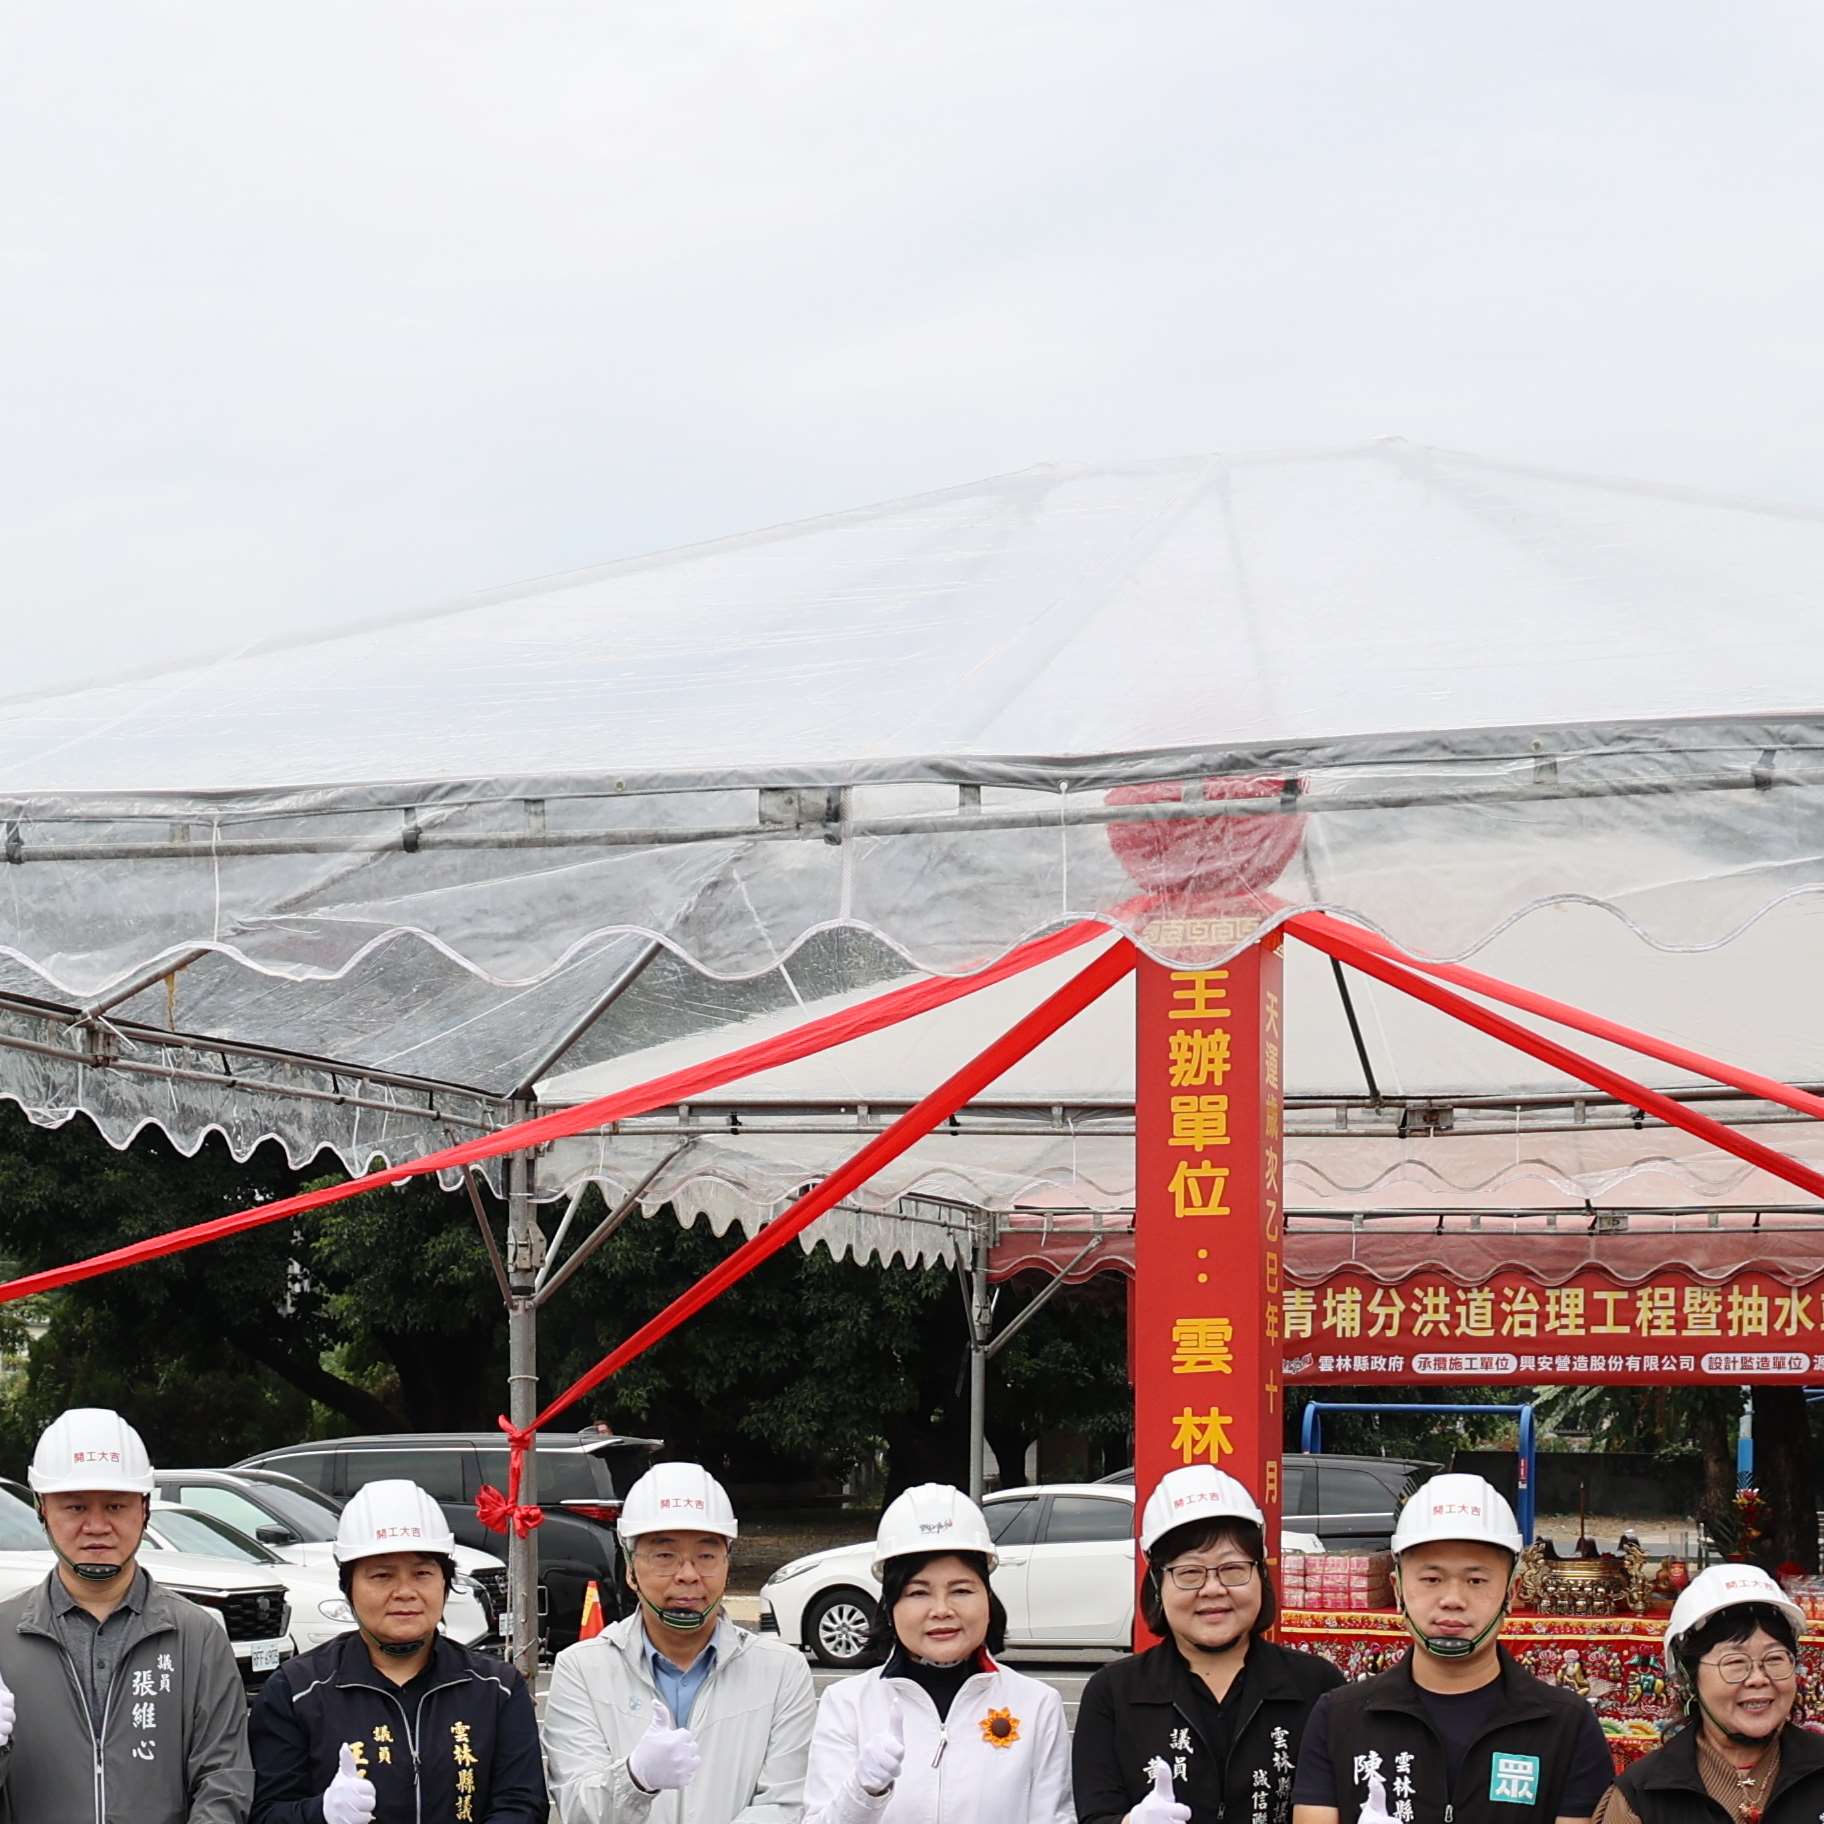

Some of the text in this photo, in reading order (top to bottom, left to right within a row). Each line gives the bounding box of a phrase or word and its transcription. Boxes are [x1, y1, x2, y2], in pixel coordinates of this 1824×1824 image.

[1318, 1354, 1405, 1372] 雲林縣政府
[1417, 1355, 1511, 1372] 承攬施工單位
[1519, 1354, 1695, 1372] 興安營造股份有限公司
[1708, 1355, 1804, 1372] 設計監造單位
[157, 1653, 174, 1693] 議員
[131, 1669, 158, 1761] 張維心
[373, 1725, 394, 1765] 議員
[1169, 1727, 1194, 1783] 議員
